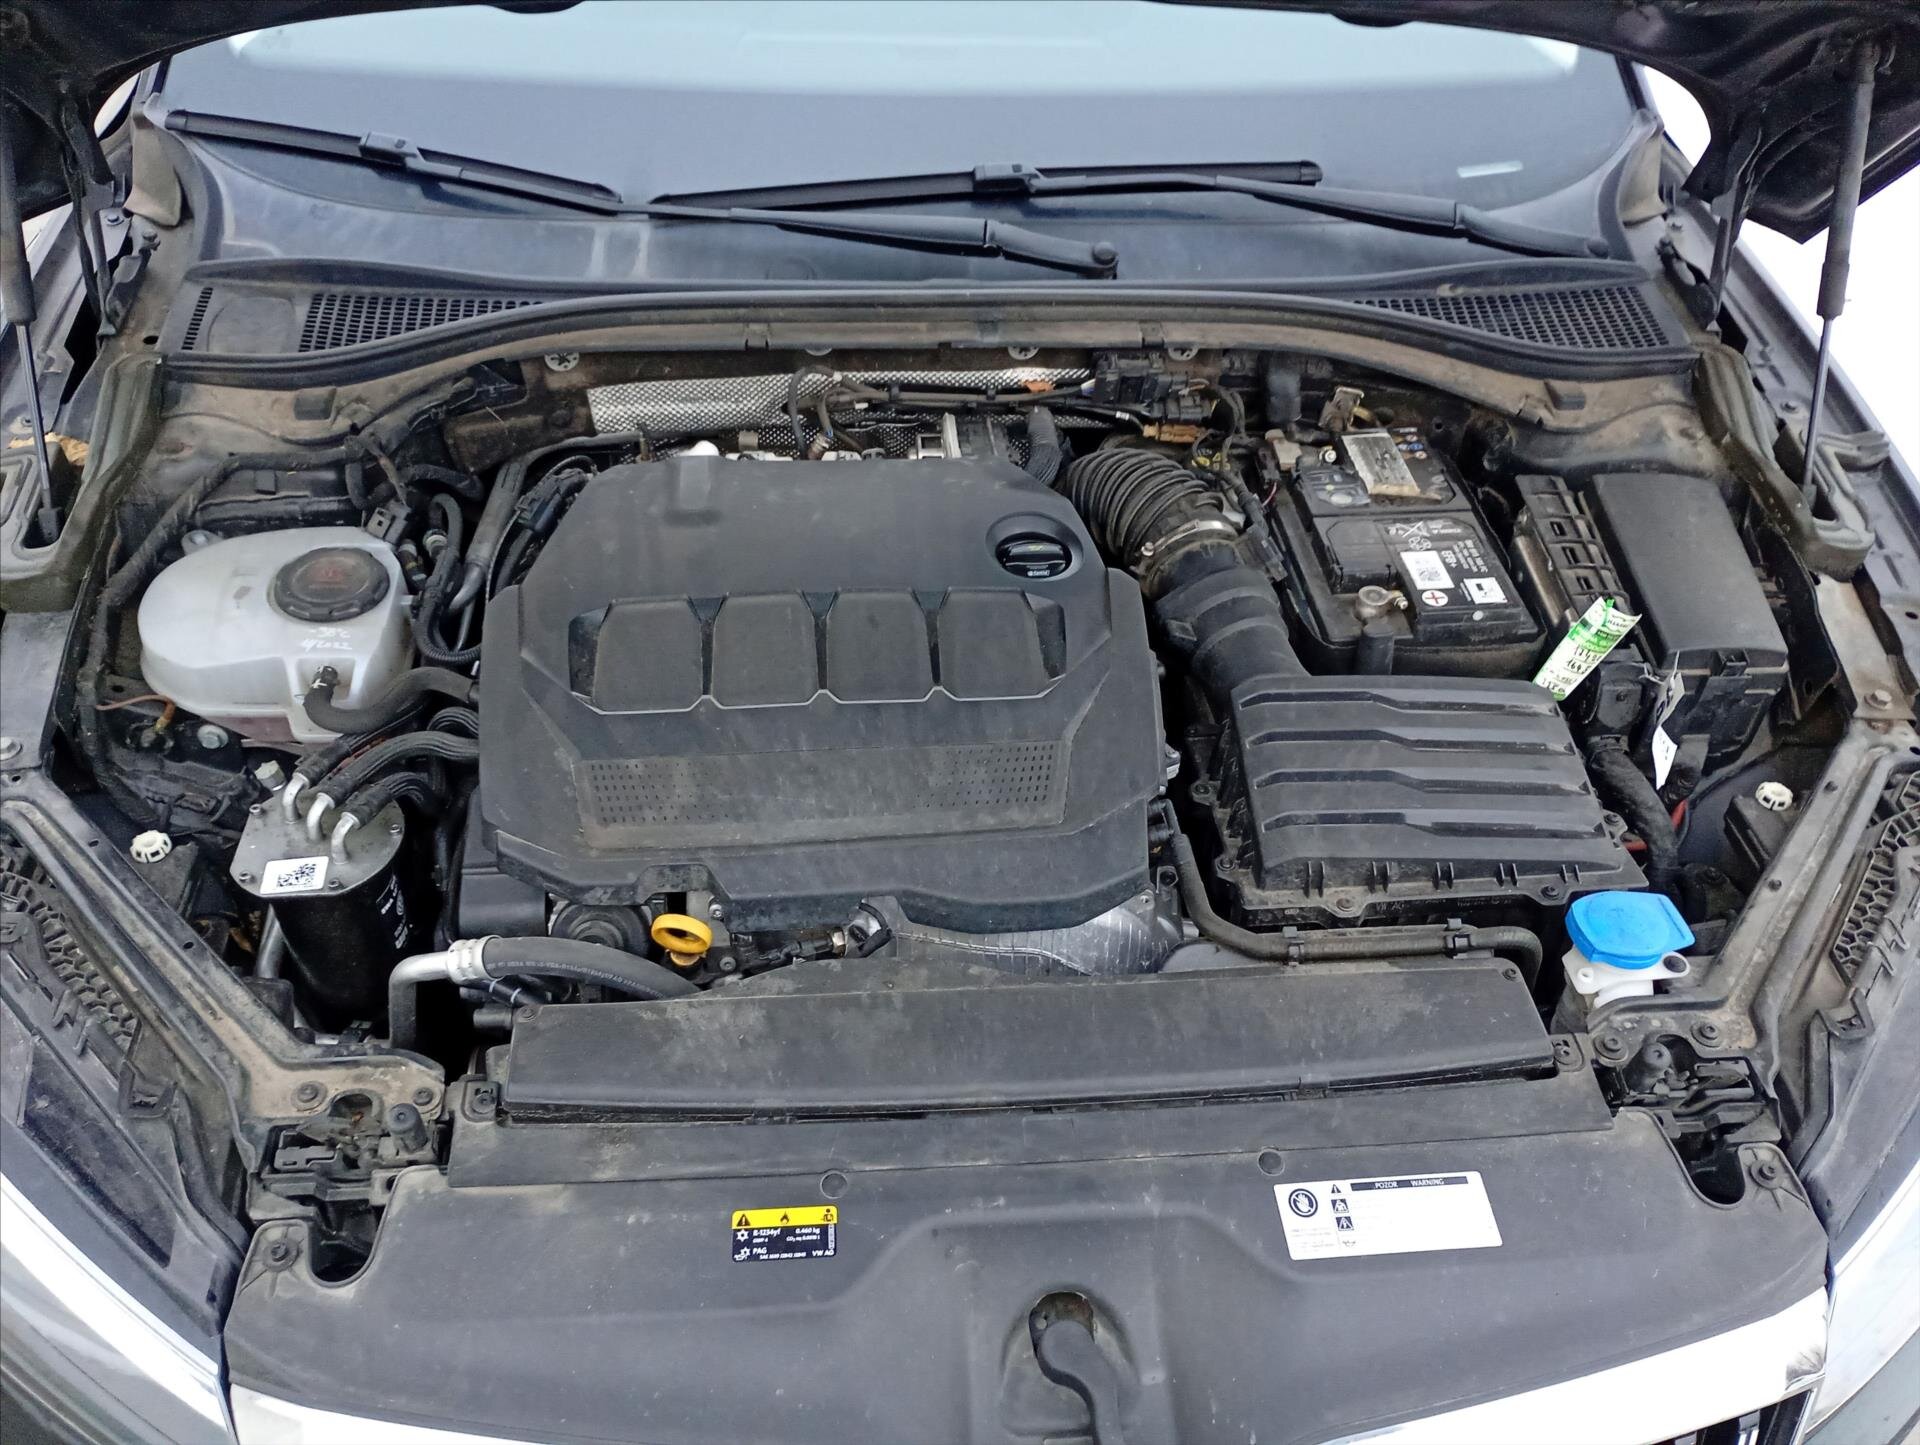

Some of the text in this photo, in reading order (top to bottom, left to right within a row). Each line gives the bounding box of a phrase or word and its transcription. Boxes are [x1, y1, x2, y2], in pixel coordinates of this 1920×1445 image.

[1374, 1178, 1445, 1189] POZOR WARNING
[752, 1228, 781, 1237] R-1234yf
